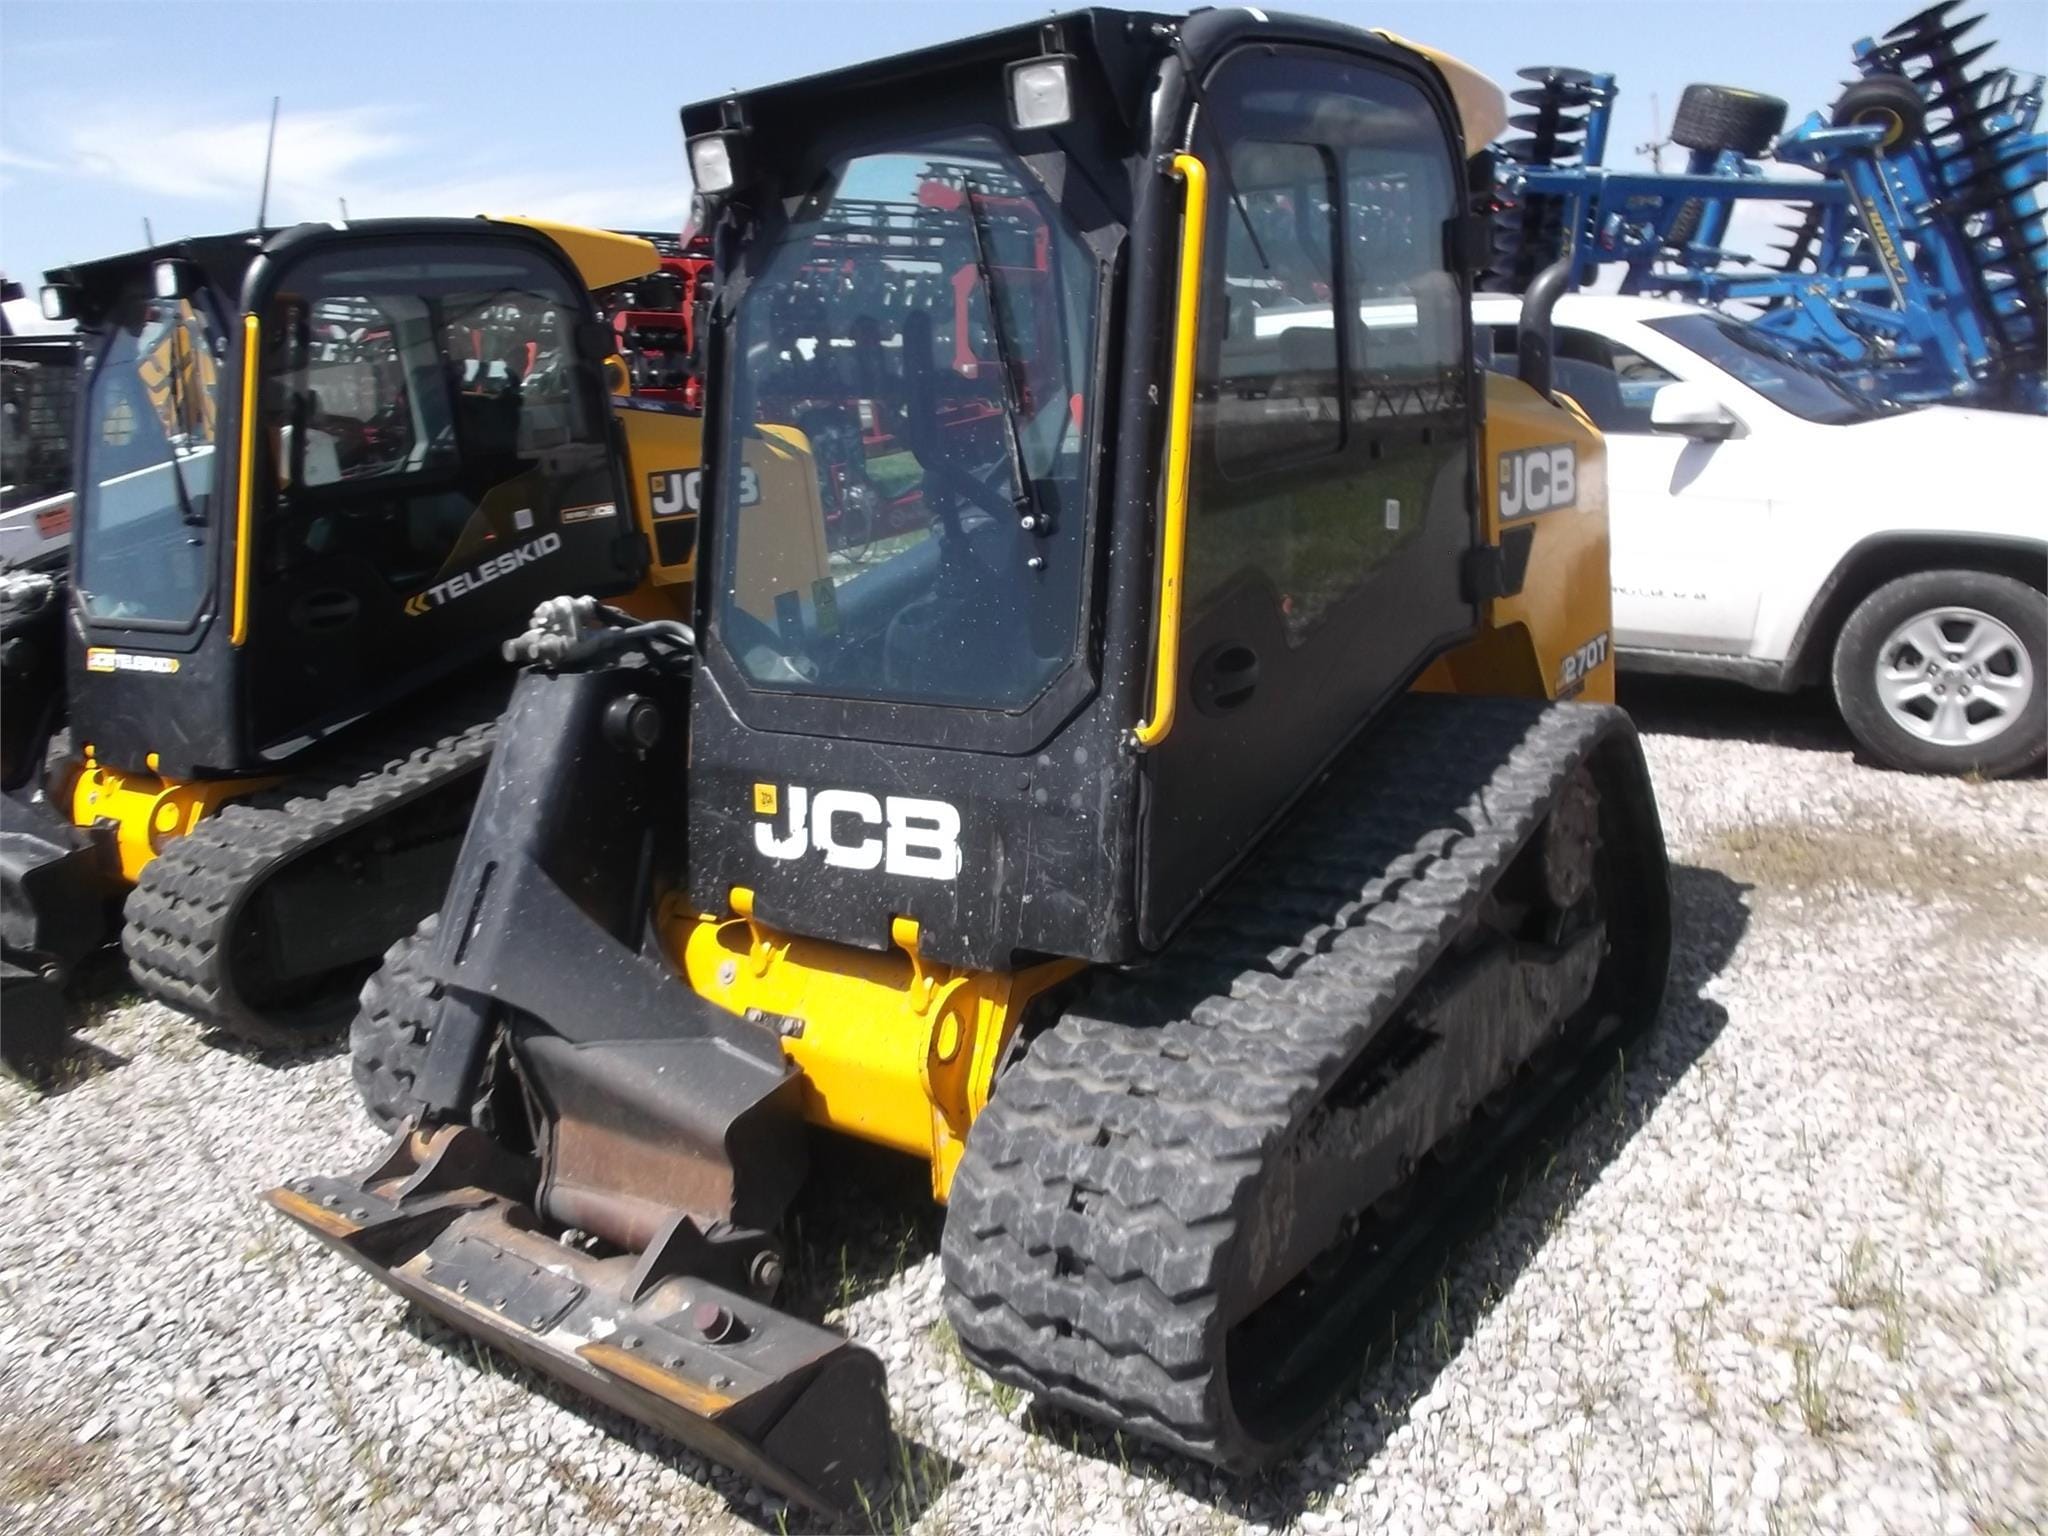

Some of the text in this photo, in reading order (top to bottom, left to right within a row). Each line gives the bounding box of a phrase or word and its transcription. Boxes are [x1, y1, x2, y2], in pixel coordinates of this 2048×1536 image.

[1501, 447, 1575, 516] JCB
[428, 532, 561, 605] TELESKID
[755, 785, 963, 881] JCB
